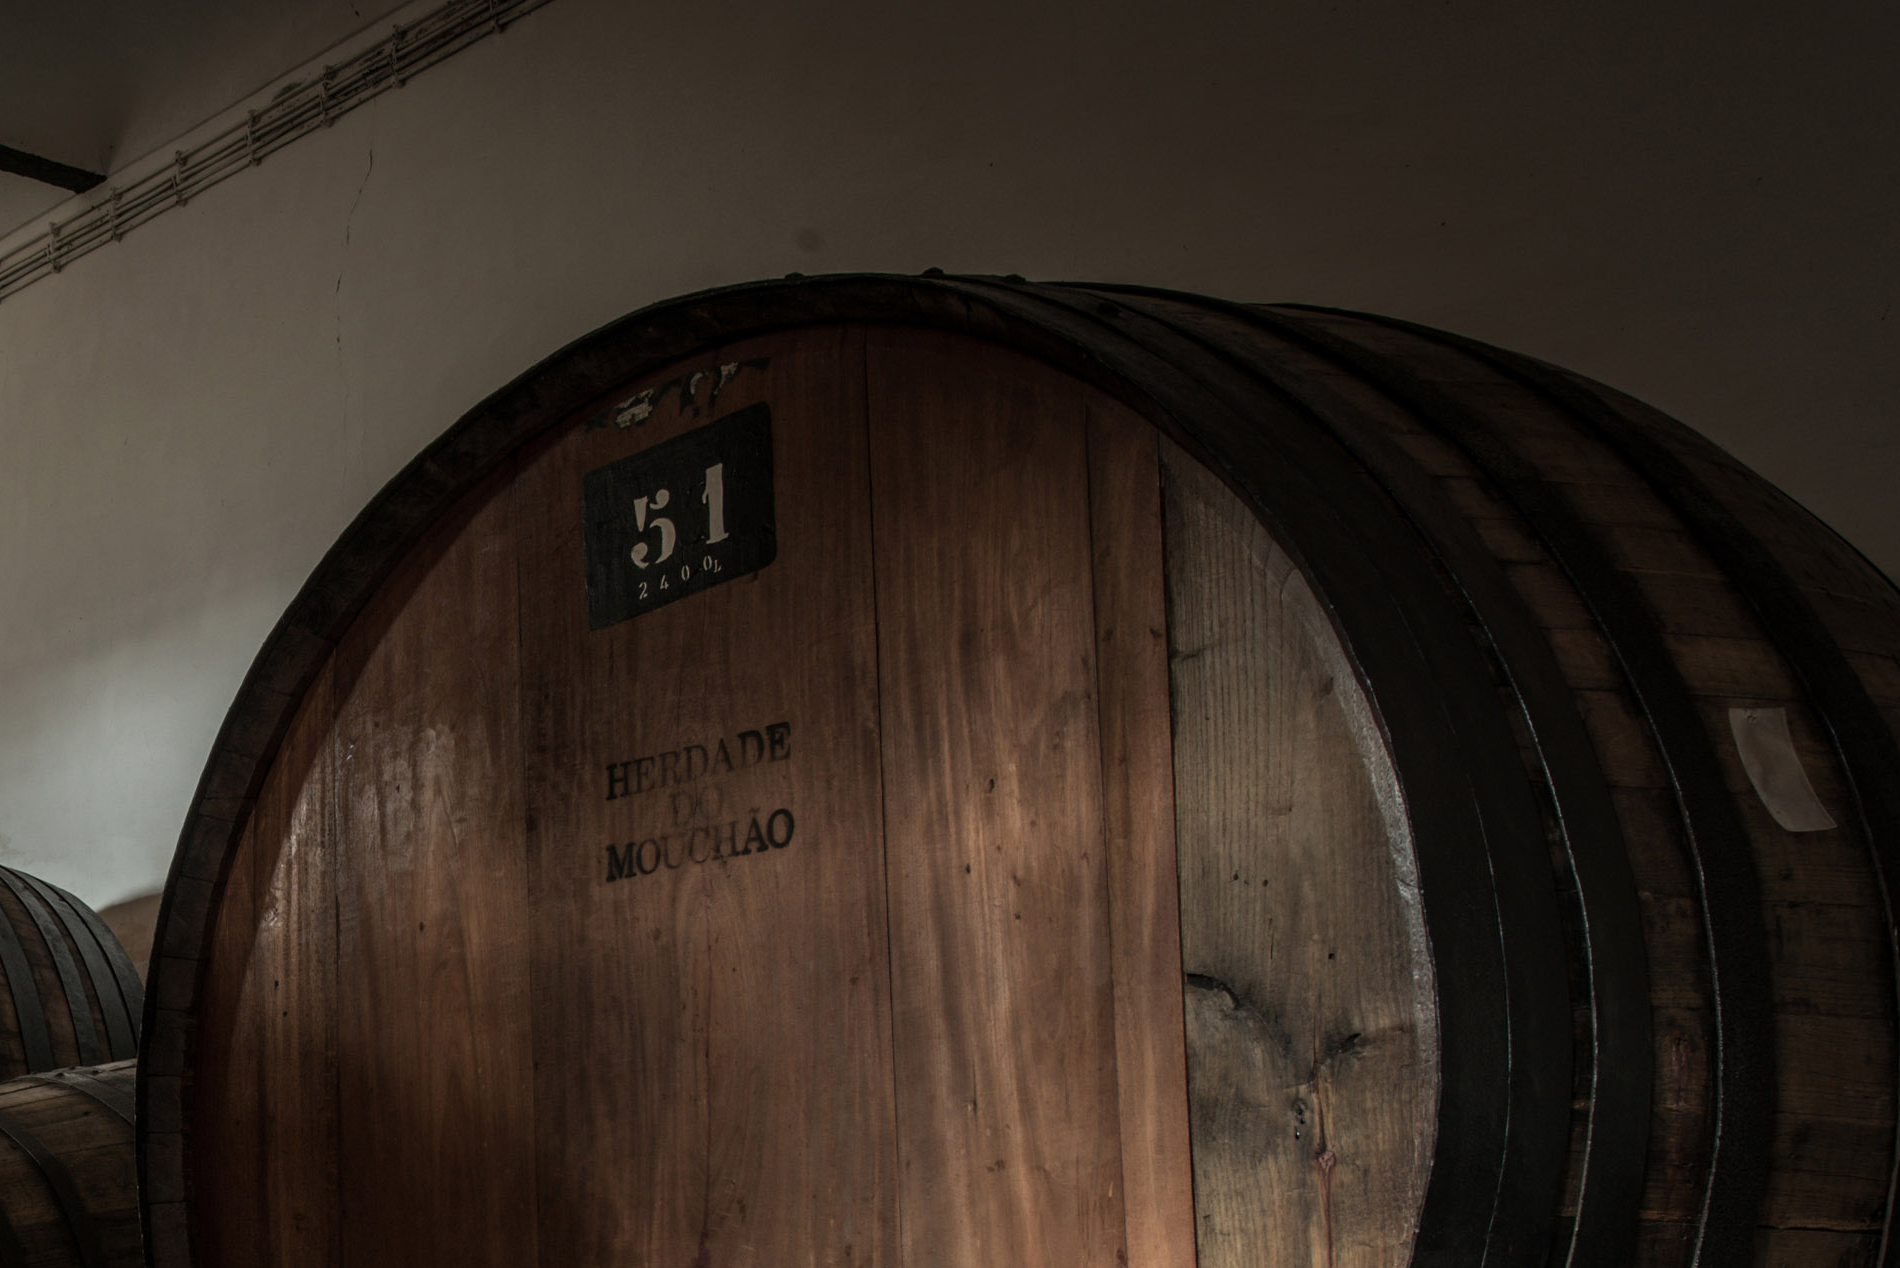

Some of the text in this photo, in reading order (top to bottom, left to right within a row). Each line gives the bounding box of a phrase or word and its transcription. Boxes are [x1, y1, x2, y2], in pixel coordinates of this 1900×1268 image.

[631, 462, 729, 569] 51
[605, 721, 791, 800] HERDADE
[669, 784, 723, 825] DO
[605, 807, 795, 883] MOUCHÃO
